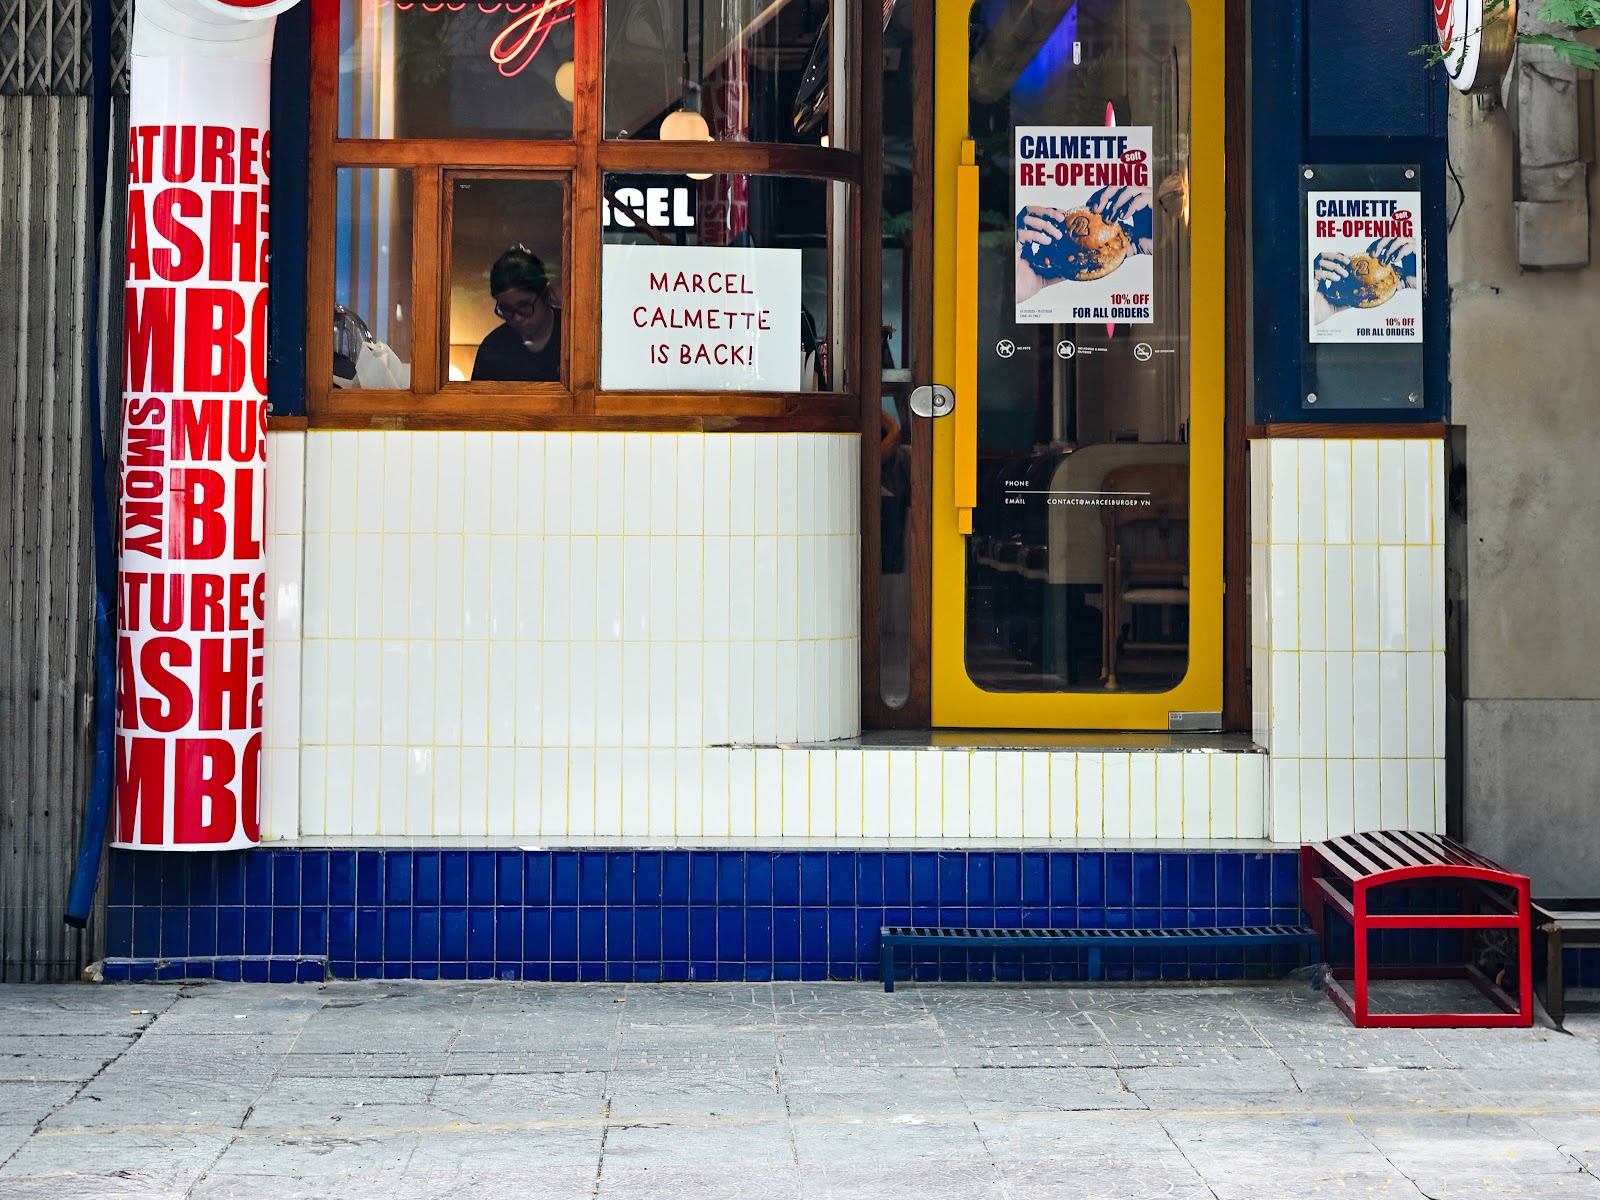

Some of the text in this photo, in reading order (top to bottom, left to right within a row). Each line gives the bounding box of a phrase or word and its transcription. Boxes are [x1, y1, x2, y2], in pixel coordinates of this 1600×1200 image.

[1020, 135, 1128, 160] CALMETTE
[1125, 151, 1142, 163] soft
[1020, 163, 1149, 187] RE-OPENING
[1316, 199, 1398, 218] CALMETTE
[1316, 220, 1414, 238] RE-OPENING
[650, 271, 754, 295] MARCEL
[1110, 293, 1150, 306] 10% OFF
[633, 306, 771, 331] CALMETTE
[1072, 307, 1150, 319] FOR ALL ORDERS
[1385, 317, 1415, 327] 10% OFF
[1356, 327, 1415, 337] FOR ALL ORDERS
[650, 343, 754, 366] IS BACK!
[124, 397, 166, 560] SMOKY
